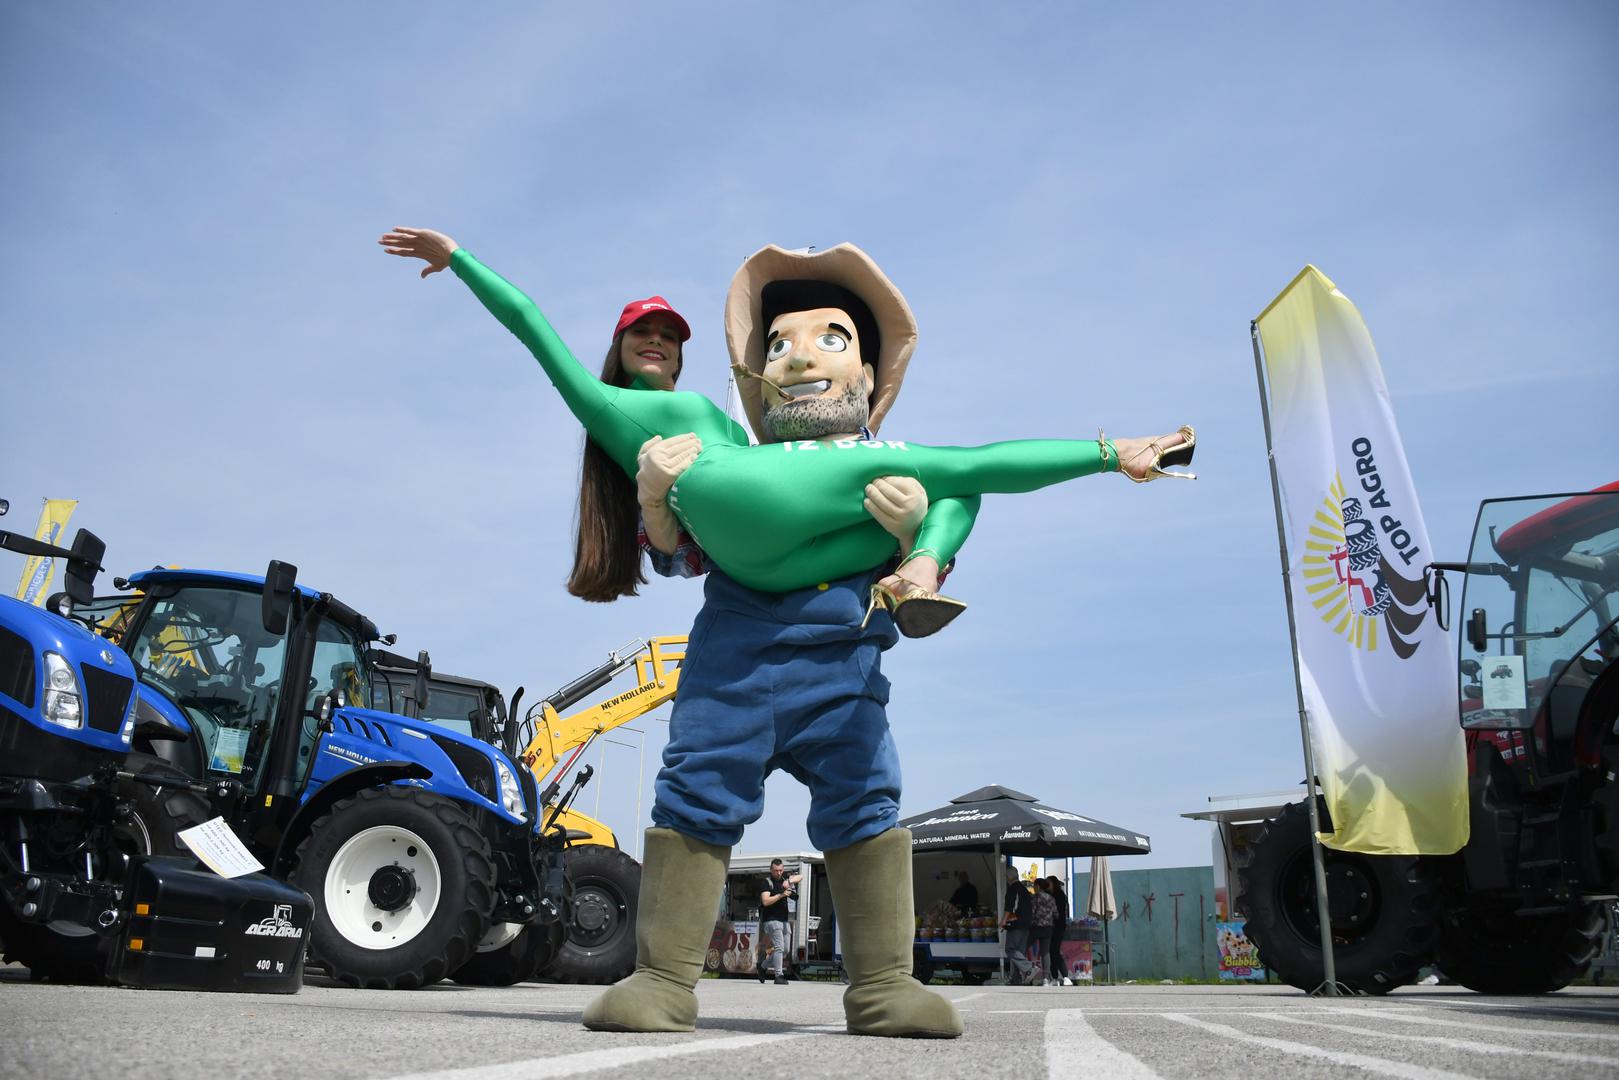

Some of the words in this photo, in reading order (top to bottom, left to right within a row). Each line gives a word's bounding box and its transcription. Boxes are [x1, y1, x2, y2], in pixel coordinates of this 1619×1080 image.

[1351, 436, 1392, 510] AGRO
[1381, 514, 1421, 567] TOP
[600, 697, 620, 711] NEW
[620, 681, 656, 703] HOLLAND
[328, 744, 346, 755] NEW
[918, 836, 944, 844] NATURAL
[944, 833, 969, 841] MINERAL
[970, 832, 991, 840] WATER
[244, 923, 303, 939] AGRARIA
[256, 959, 271, 970] 400
[275, 960, 284, 973] kg
[1223, 955, 1258, 967] Bubble
